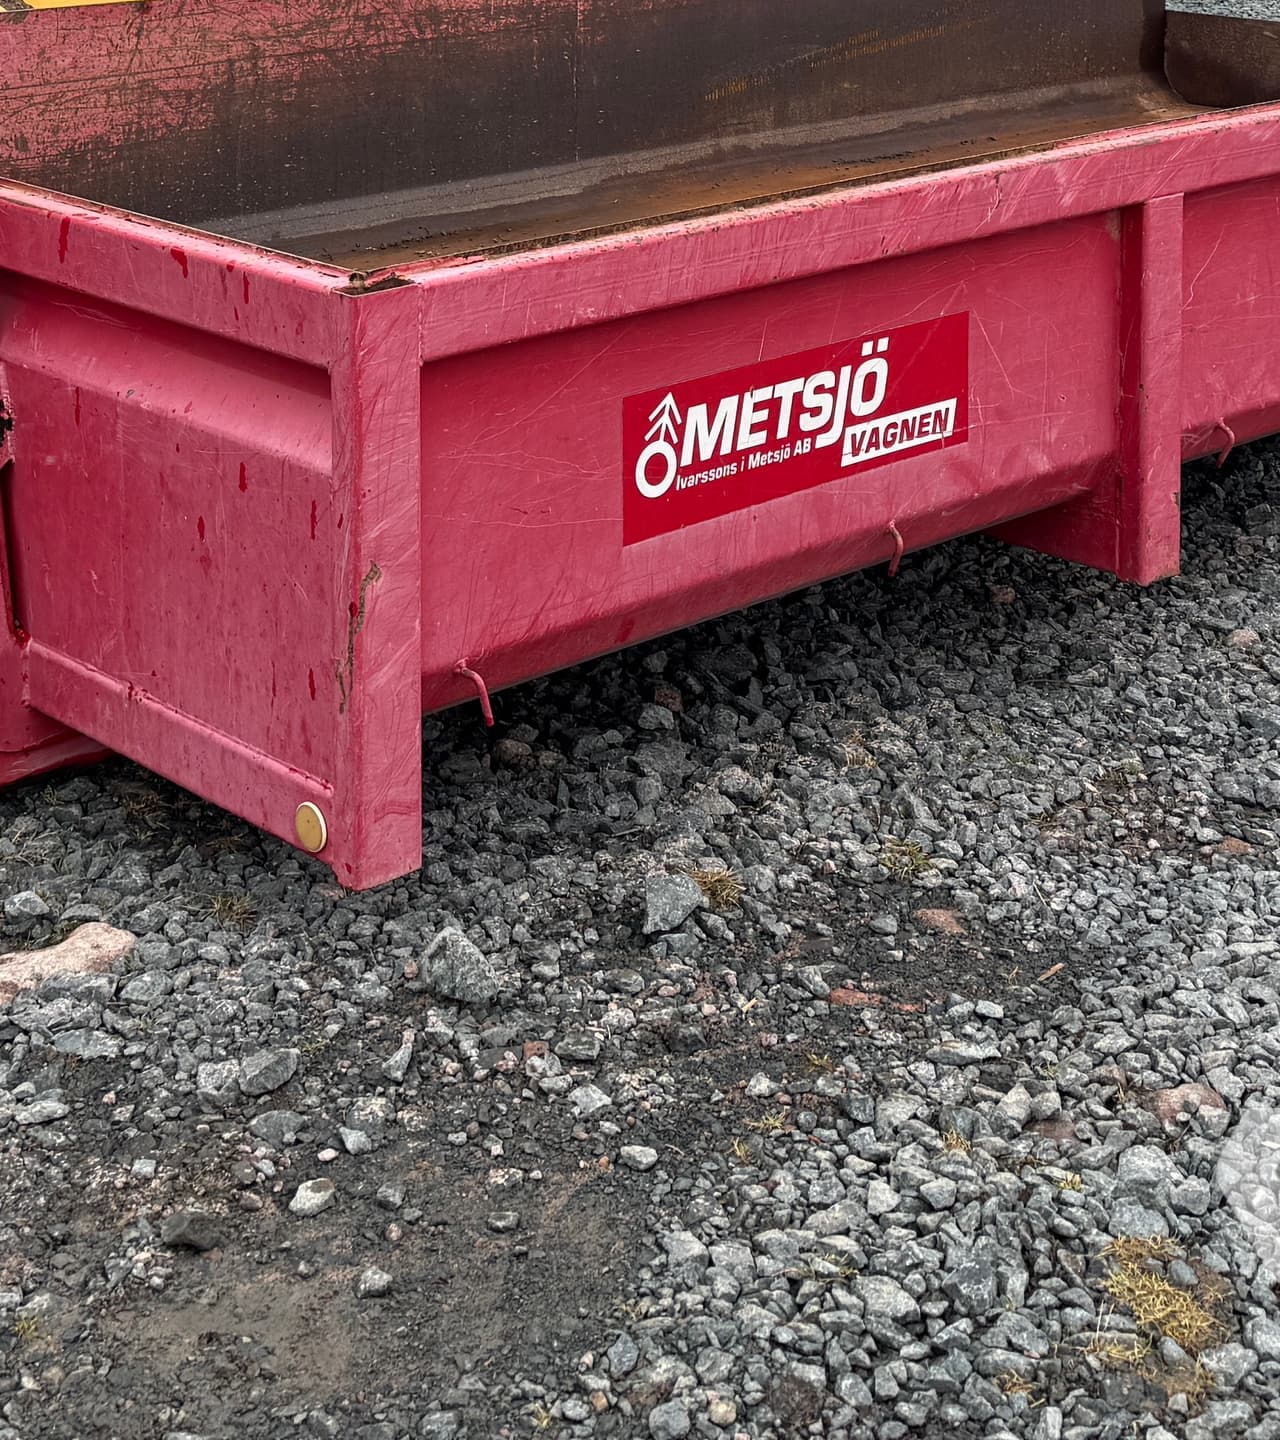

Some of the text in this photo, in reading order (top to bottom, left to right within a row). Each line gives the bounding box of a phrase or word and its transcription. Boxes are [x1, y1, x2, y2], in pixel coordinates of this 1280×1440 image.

[680, 337, 889, 467] METSJÖ
[850, 406, 950, 457] VAGNEN
[675, 437, 812, 491] Ivarssons i Metsjö AB
